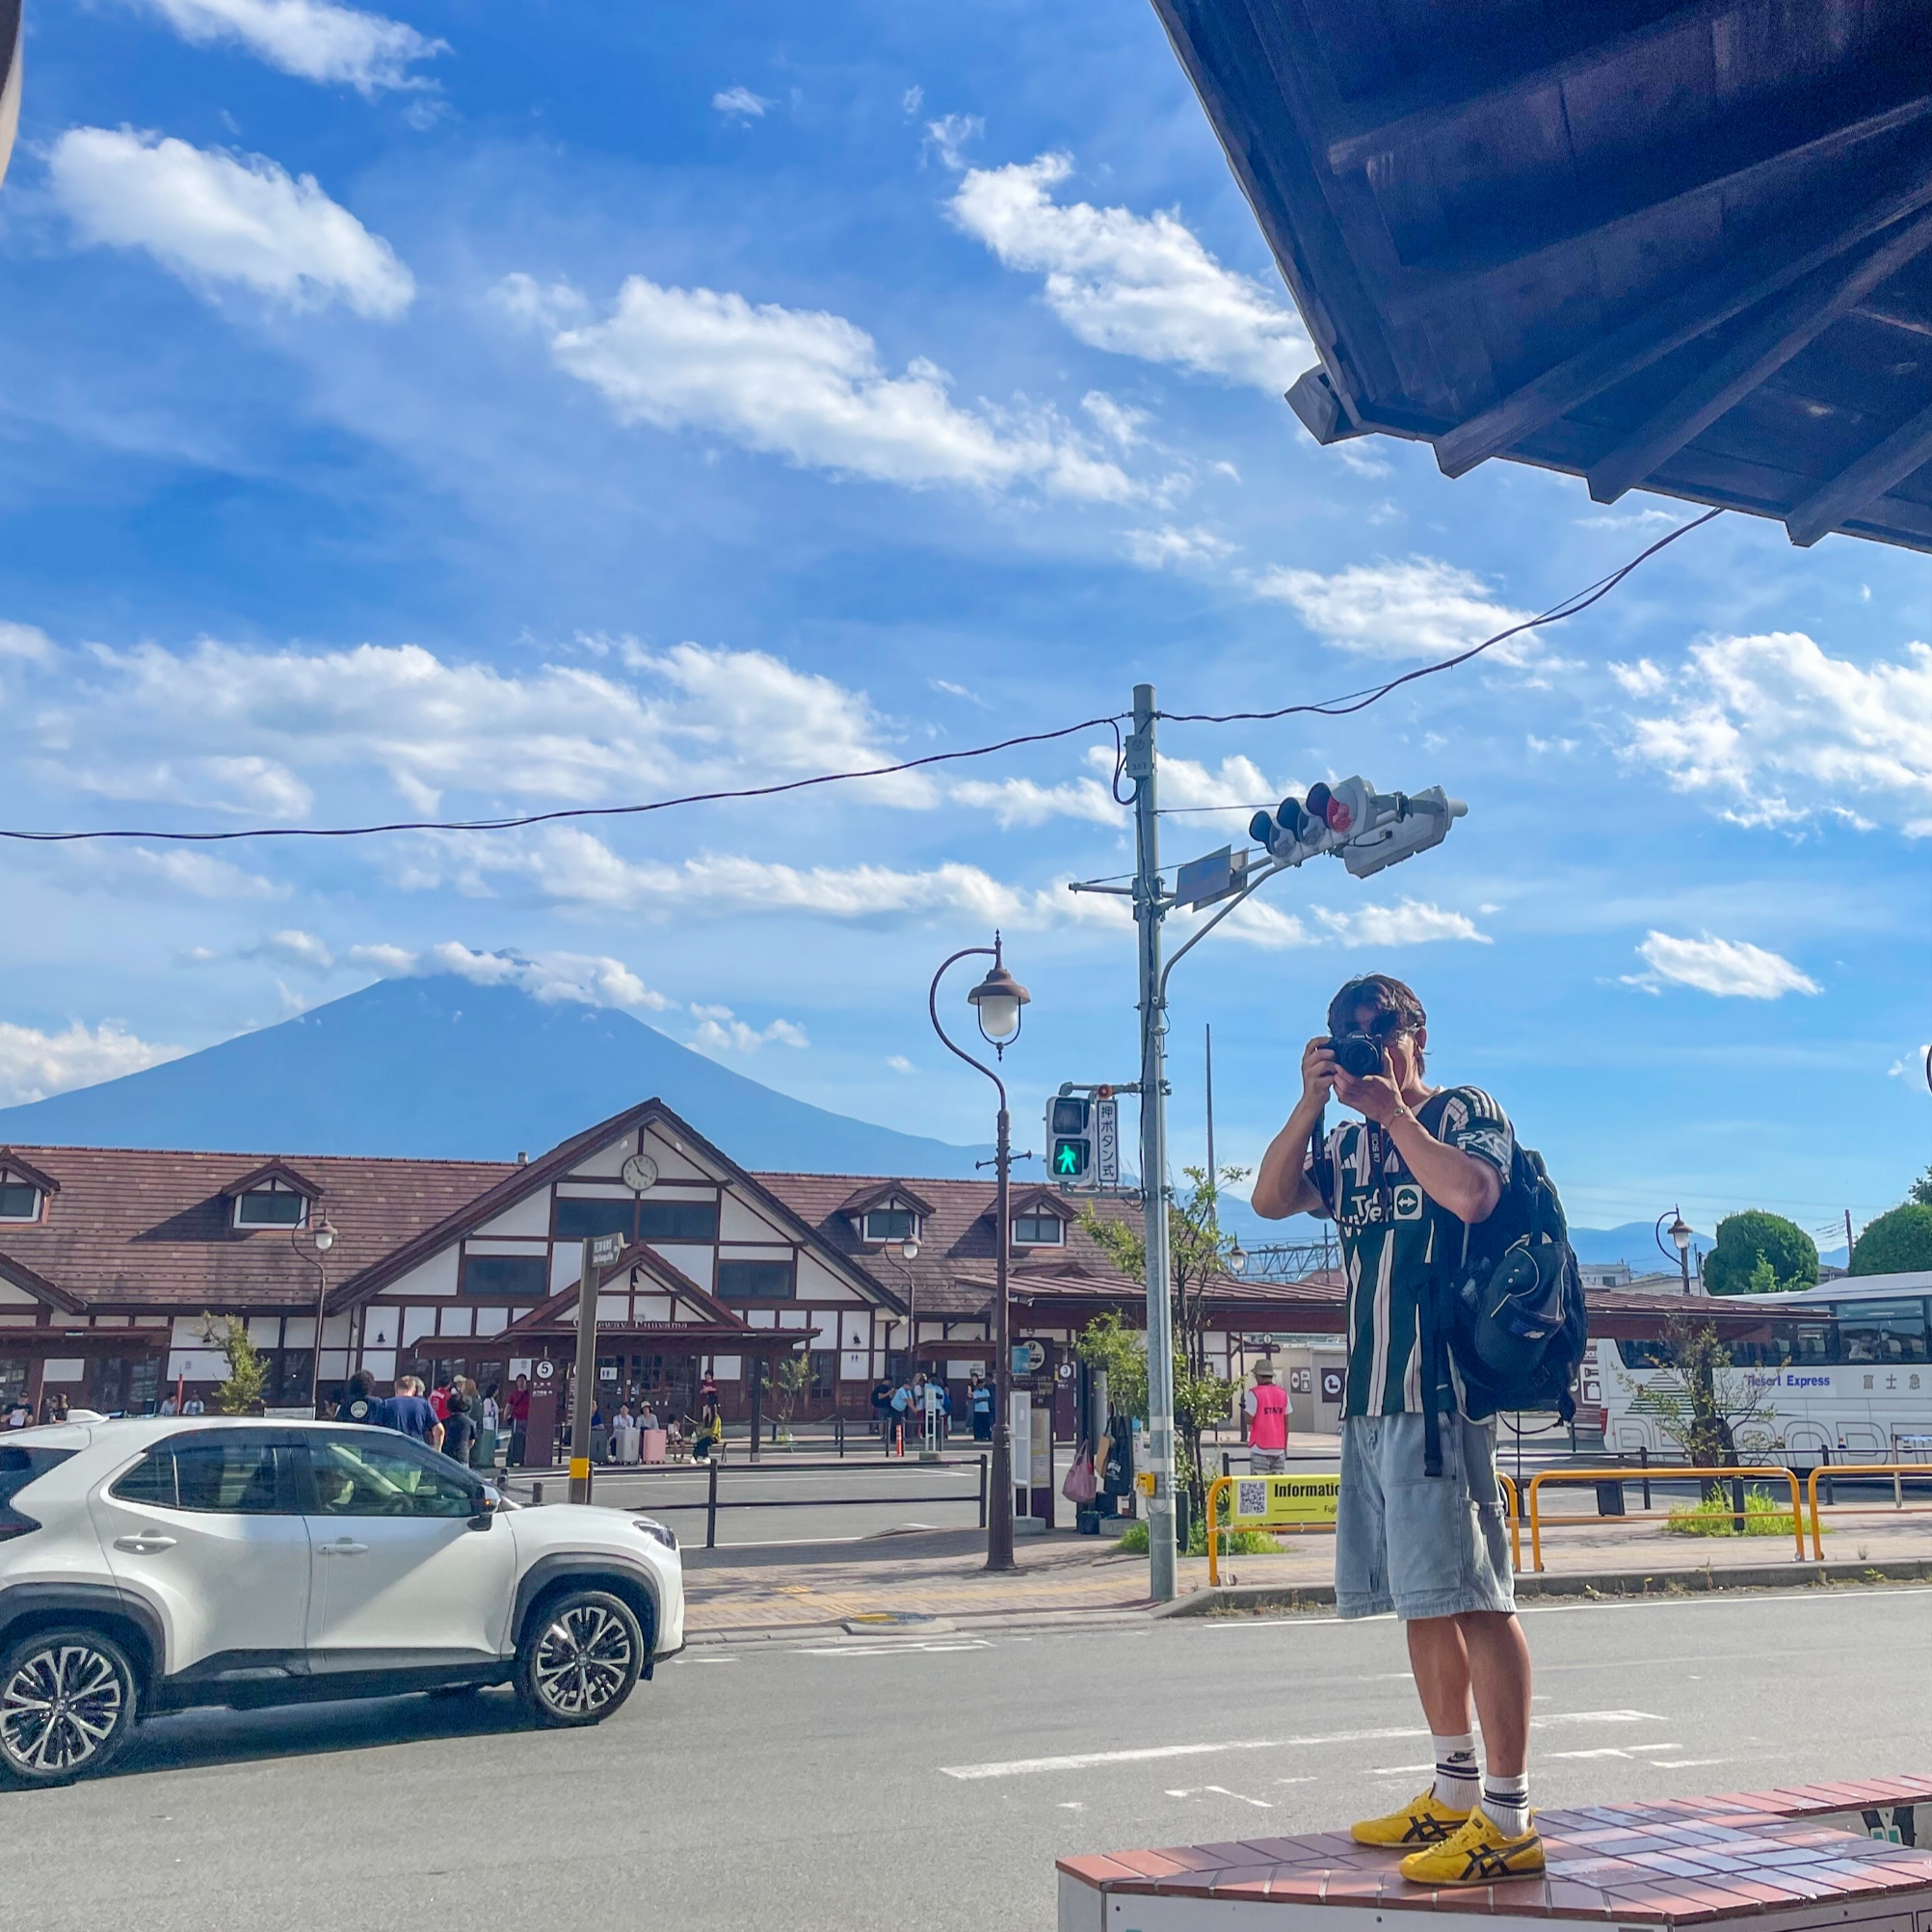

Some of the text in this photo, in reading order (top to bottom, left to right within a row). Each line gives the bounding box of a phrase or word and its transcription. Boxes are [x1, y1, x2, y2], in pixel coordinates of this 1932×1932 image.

[1100, 1106, 1114, 1177] 押ボタン式
[1370, 1132, 1381, 1163] EOS R7
[541, 1363, 549, 1374] 5
[1063, 1365, 1069, 1375] 3
[1786, 1374, 1831, 1389] Express
[1274, 1482, 1340, 1497] Informatio
[1323, 1504, 1338, 1515] Fuji
